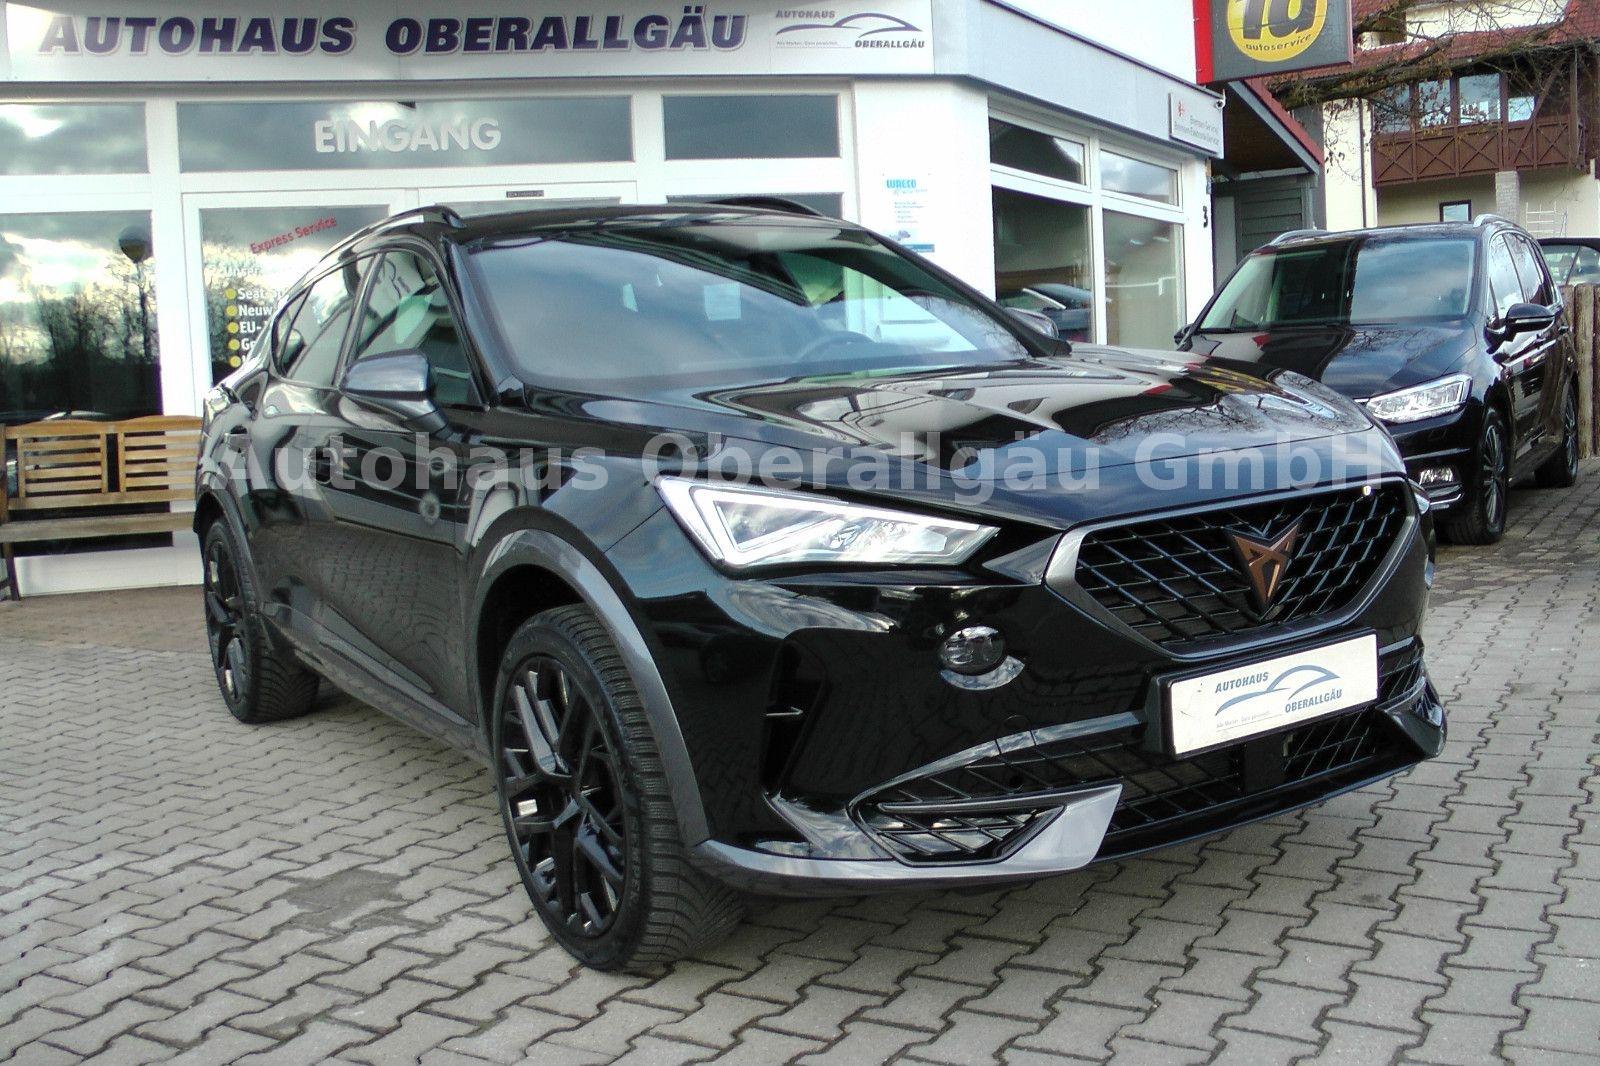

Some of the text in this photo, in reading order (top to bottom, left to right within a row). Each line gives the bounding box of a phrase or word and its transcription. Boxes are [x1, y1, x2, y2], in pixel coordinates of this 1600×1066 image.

[775, 10, 836, 19] AUTOHAUS
[38, 5, 748, 56] AUTOHAUS OBERALLGÄU
[1245, 34, 1312, 51] autoservice
[854, 40, 926, 49] OBERALLGÄU
[314, 117, 501, 153] EINGANG
[250, 216, 337, 255] Express Service
[1214, 671, 1270, 694] AUTOHAUS
[1285, 688, 1344, 714] OBERALLGÄU
